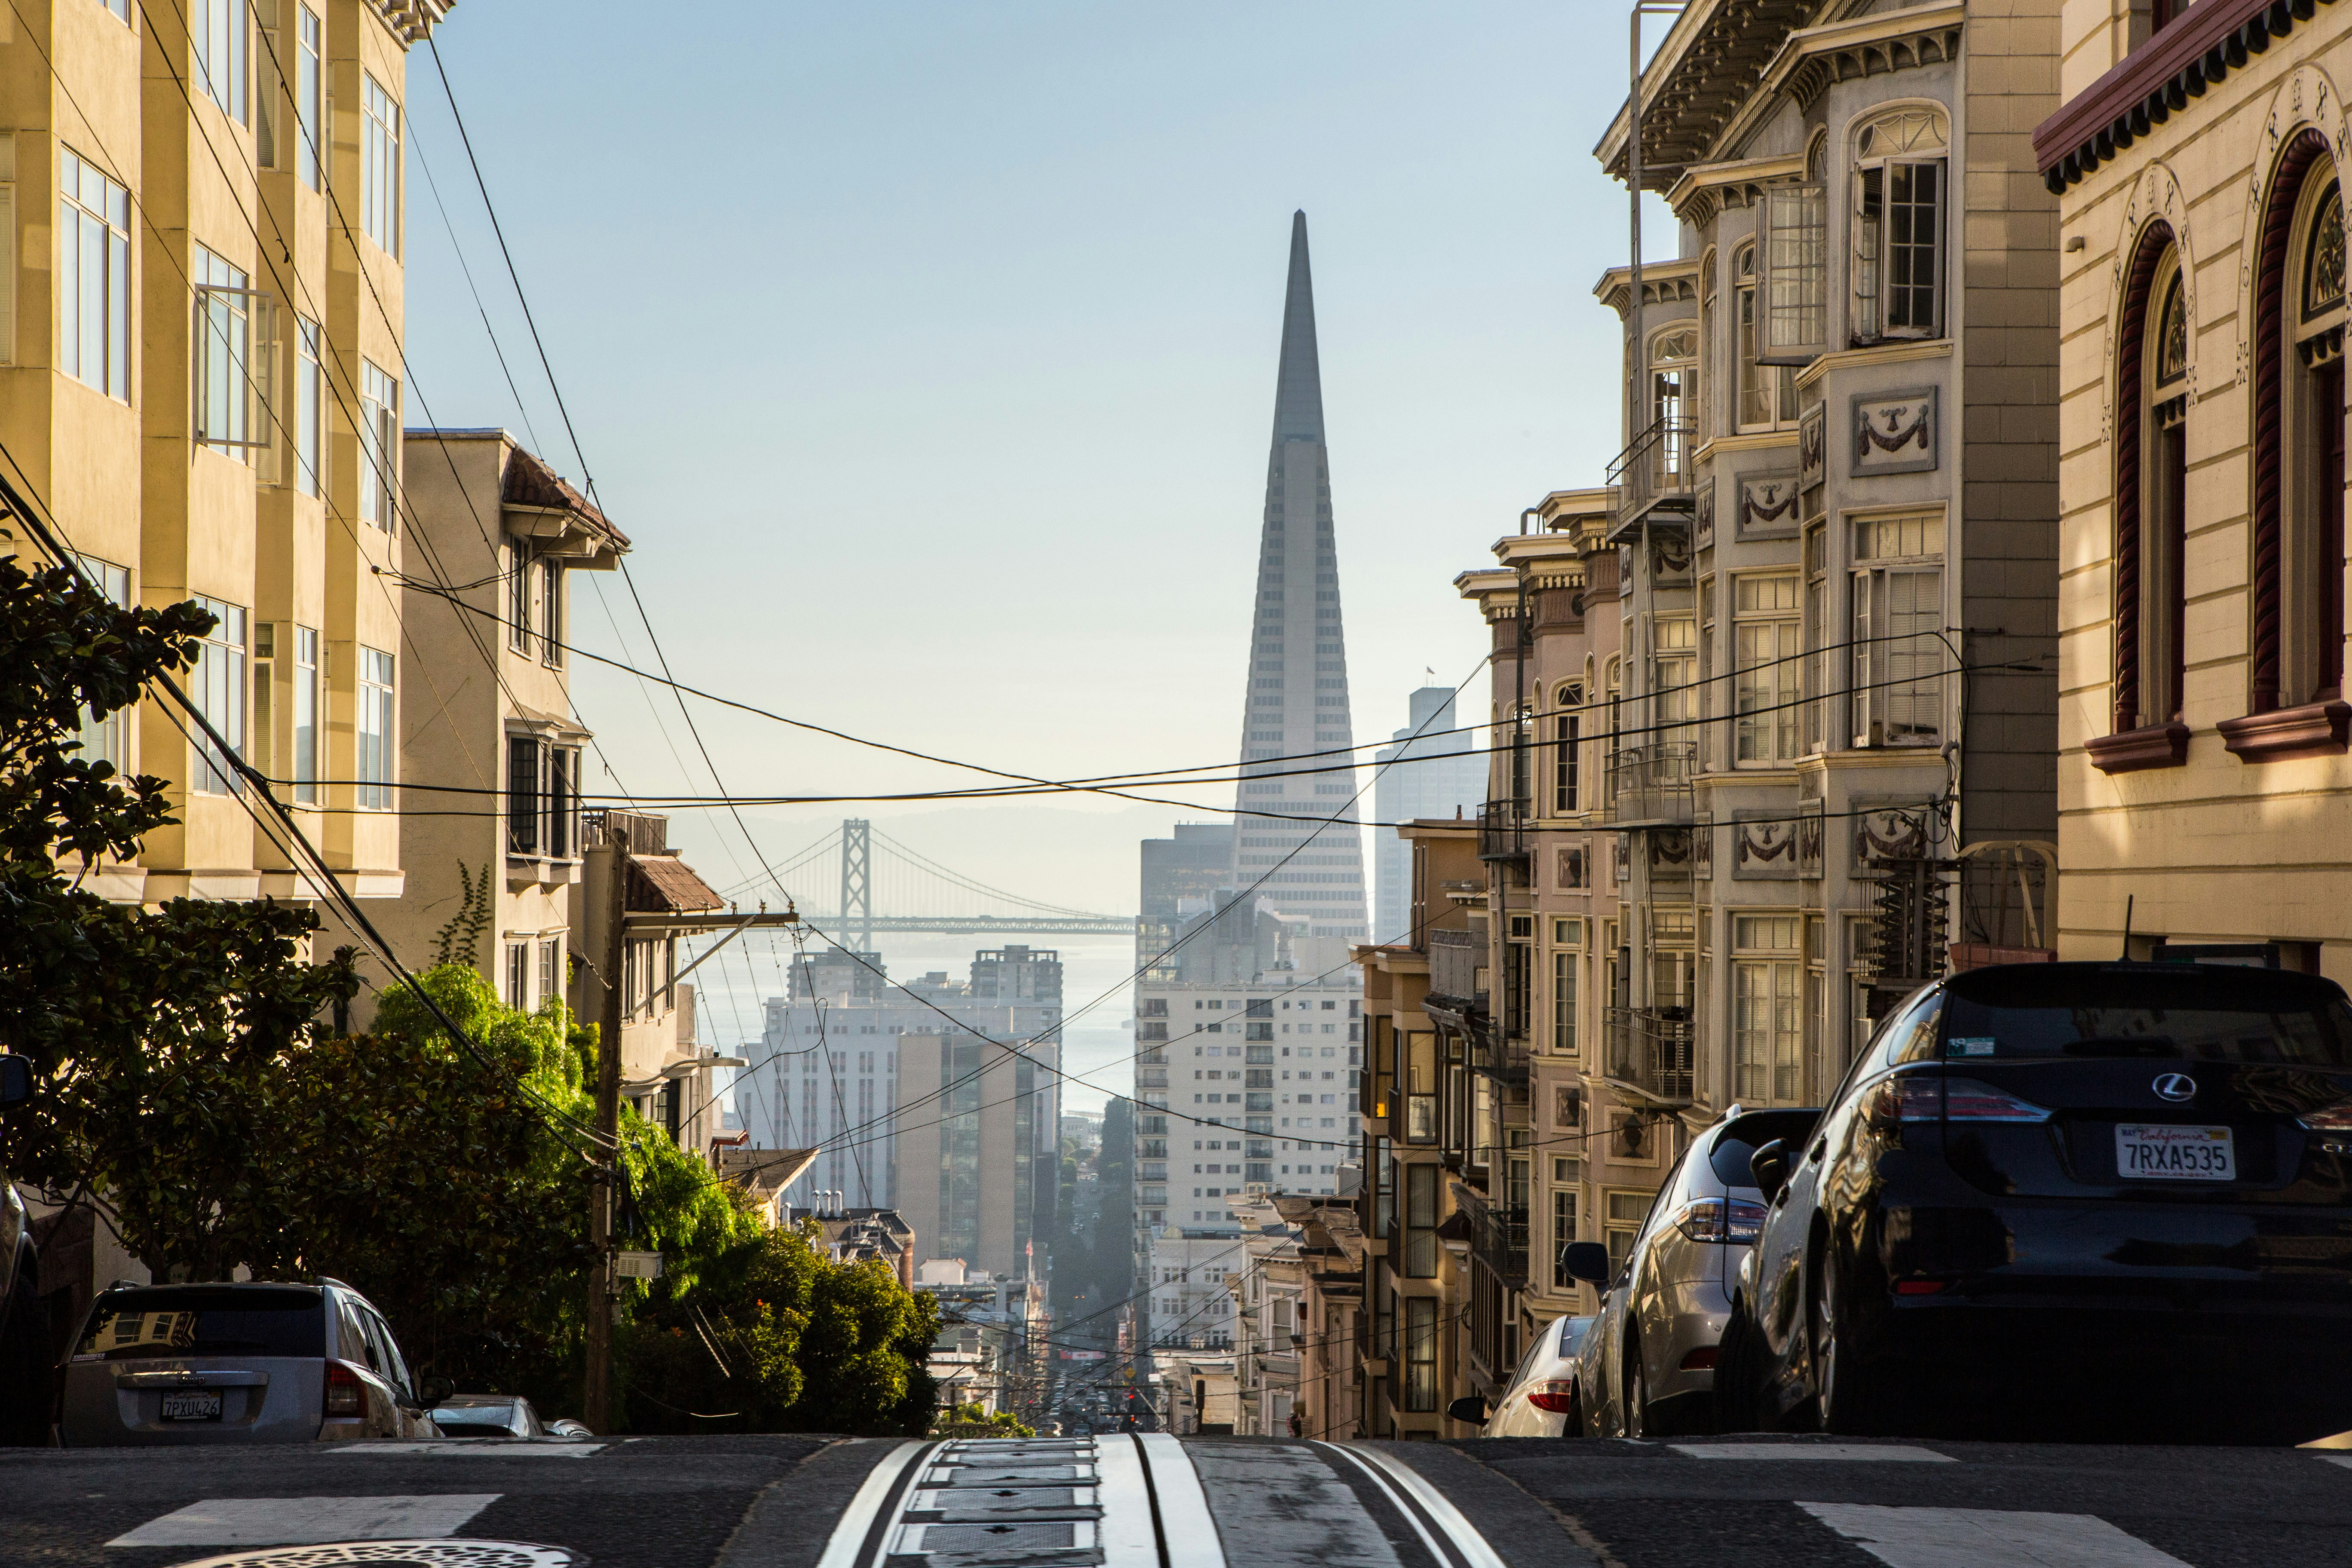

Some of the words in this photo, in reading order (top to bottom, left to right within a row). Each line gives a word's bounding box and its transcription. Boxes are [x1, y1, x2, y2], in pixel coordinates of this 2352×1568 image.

[2141, 1128, 2211, 1144] California
[2125, 1144, 2226, 1171] 7RXA535
[178, 1376, 205, 1384] Jeep
[173, 1390, 210, 1402] California
[165, 1401, 217, 1415] 7PXU426
